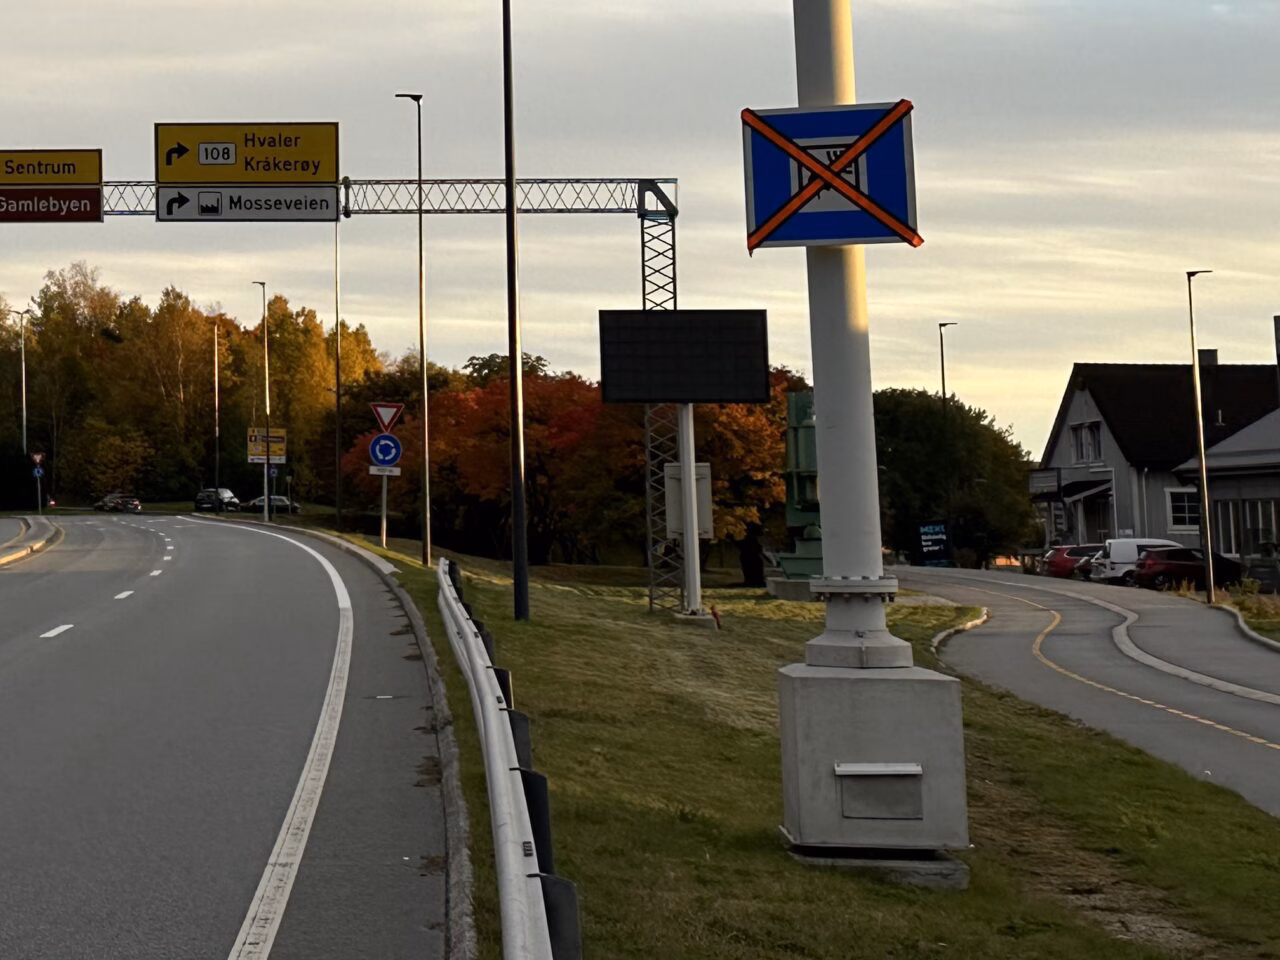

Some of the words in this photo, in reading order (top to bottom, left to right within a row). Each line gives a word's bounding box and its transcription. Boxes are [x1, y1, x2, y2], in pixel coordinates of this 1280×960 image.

[244, 132, 301, 148] Hvaler
[204, 147, 231, 161] 108
[4, 159, 77, 175] Sentrum
[244, 156, 321, 176] Kråkerøy
[229, 195, 329, 211] Mosseveien
